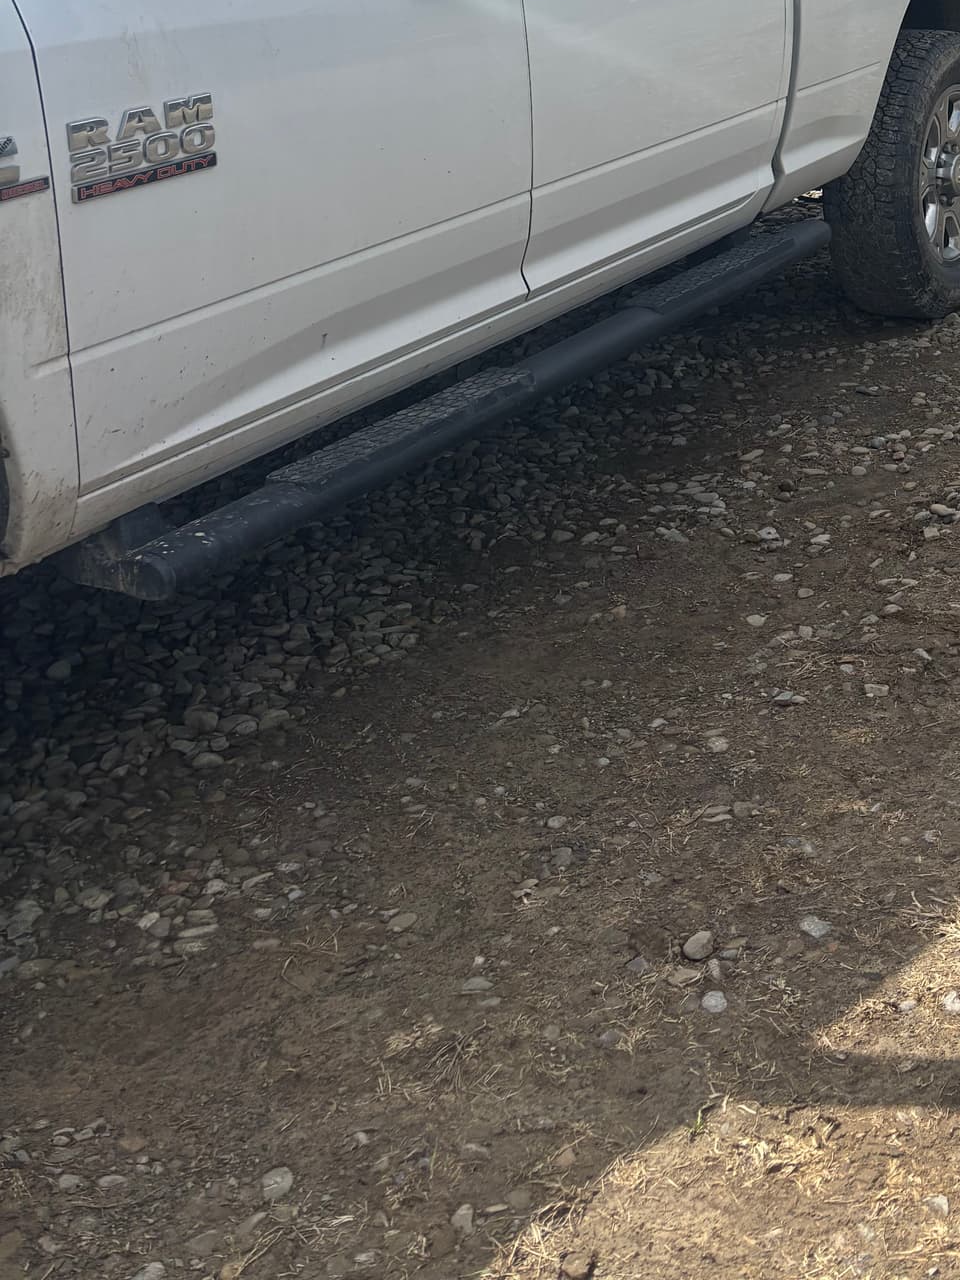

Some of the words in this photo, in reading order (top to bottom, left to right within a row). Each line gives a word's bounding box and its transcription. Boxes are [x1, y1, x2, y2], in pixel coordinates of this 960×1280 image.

[65, 92, 214, 153] RAM
[69, 122, 215, 184] 2500
[80, 171, 154, 199] HEAVY
[156, 155, 213, 180] DUTY
